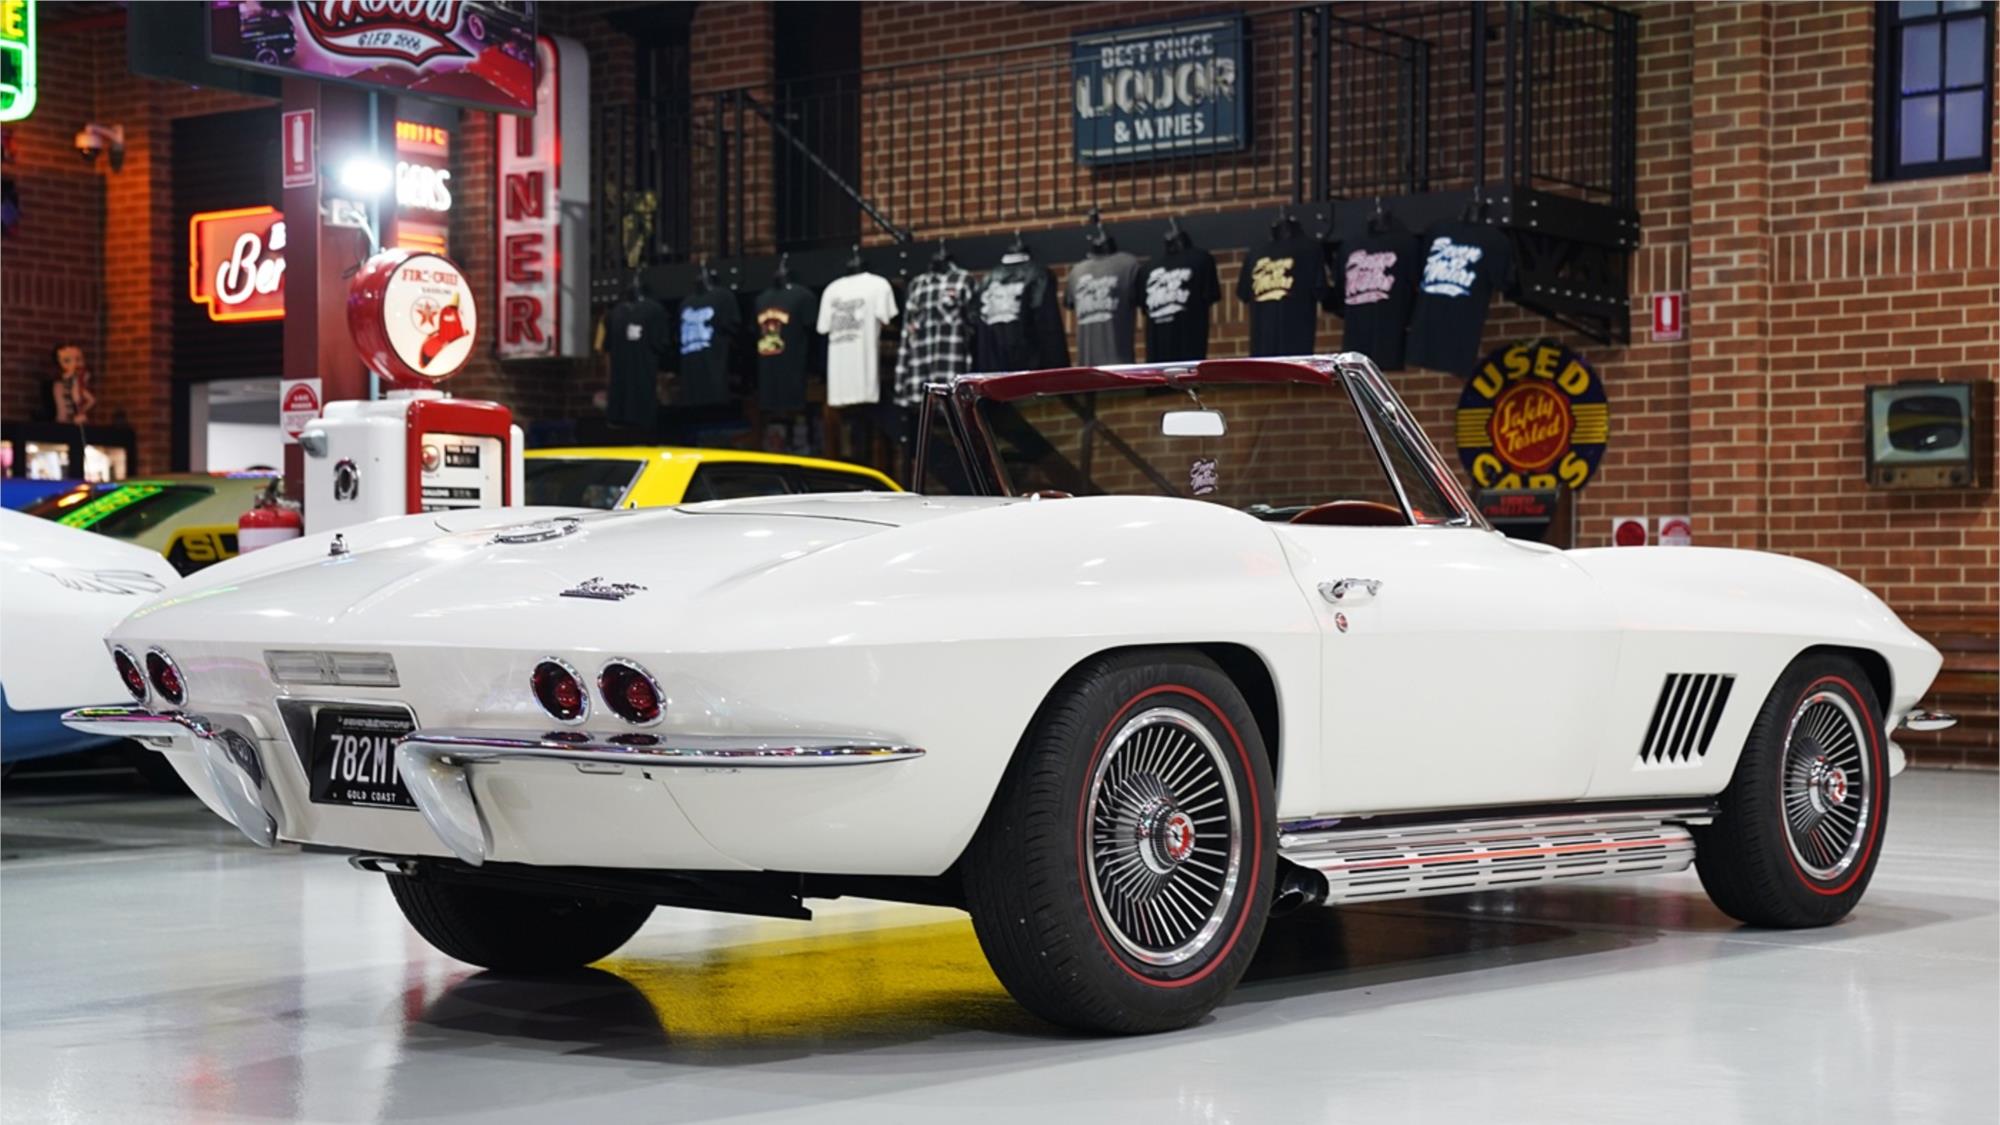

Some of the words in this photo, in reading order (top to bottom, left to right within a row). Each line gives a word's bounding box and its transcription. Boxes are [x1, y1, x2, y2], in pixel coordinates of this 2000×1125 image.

[1101, 41, 1150, 69] BEST
[1154, 33, 1213, 61] PRICE
[1076, 57, 1235, 119] LIQUOR
[1114, 120, 1130, 143] &
[1134, 112, 1205, 140] WINES
[504, 112, 544, 345] INER
[1473, 347, 1590, 399] USED
[1501, 394, 1555, 434] Safety
[1505, 414, 1560, 452] Tested
[1472, 450, 1589, 489] CARS
[347, 789, 367, 801] GOLD
[371, 791, 397, 803] COAST
